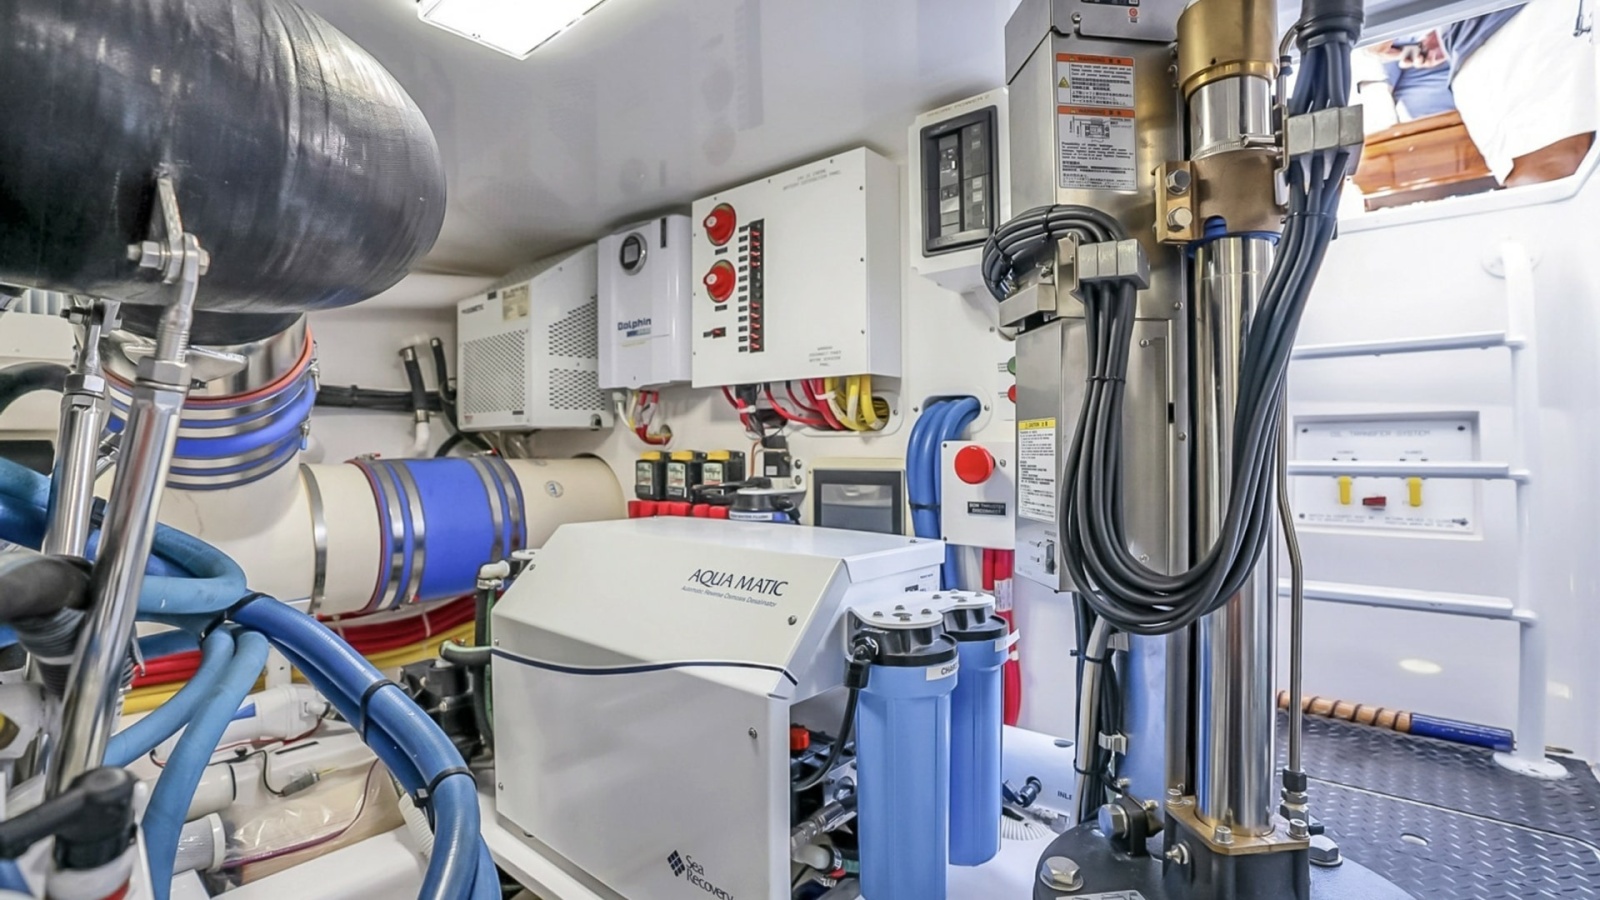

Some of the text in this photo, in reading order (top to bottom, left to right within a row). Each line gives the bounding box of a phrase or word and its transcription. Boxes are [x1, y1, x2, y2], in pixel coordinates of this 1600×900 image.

[617, 318, 652, 331] Dolphin
[1396, 429, 1431, 437] SYSTEM
[688, 569, 788, 596] AQUA MATIC
[685, 855, 705, 876] Sea
